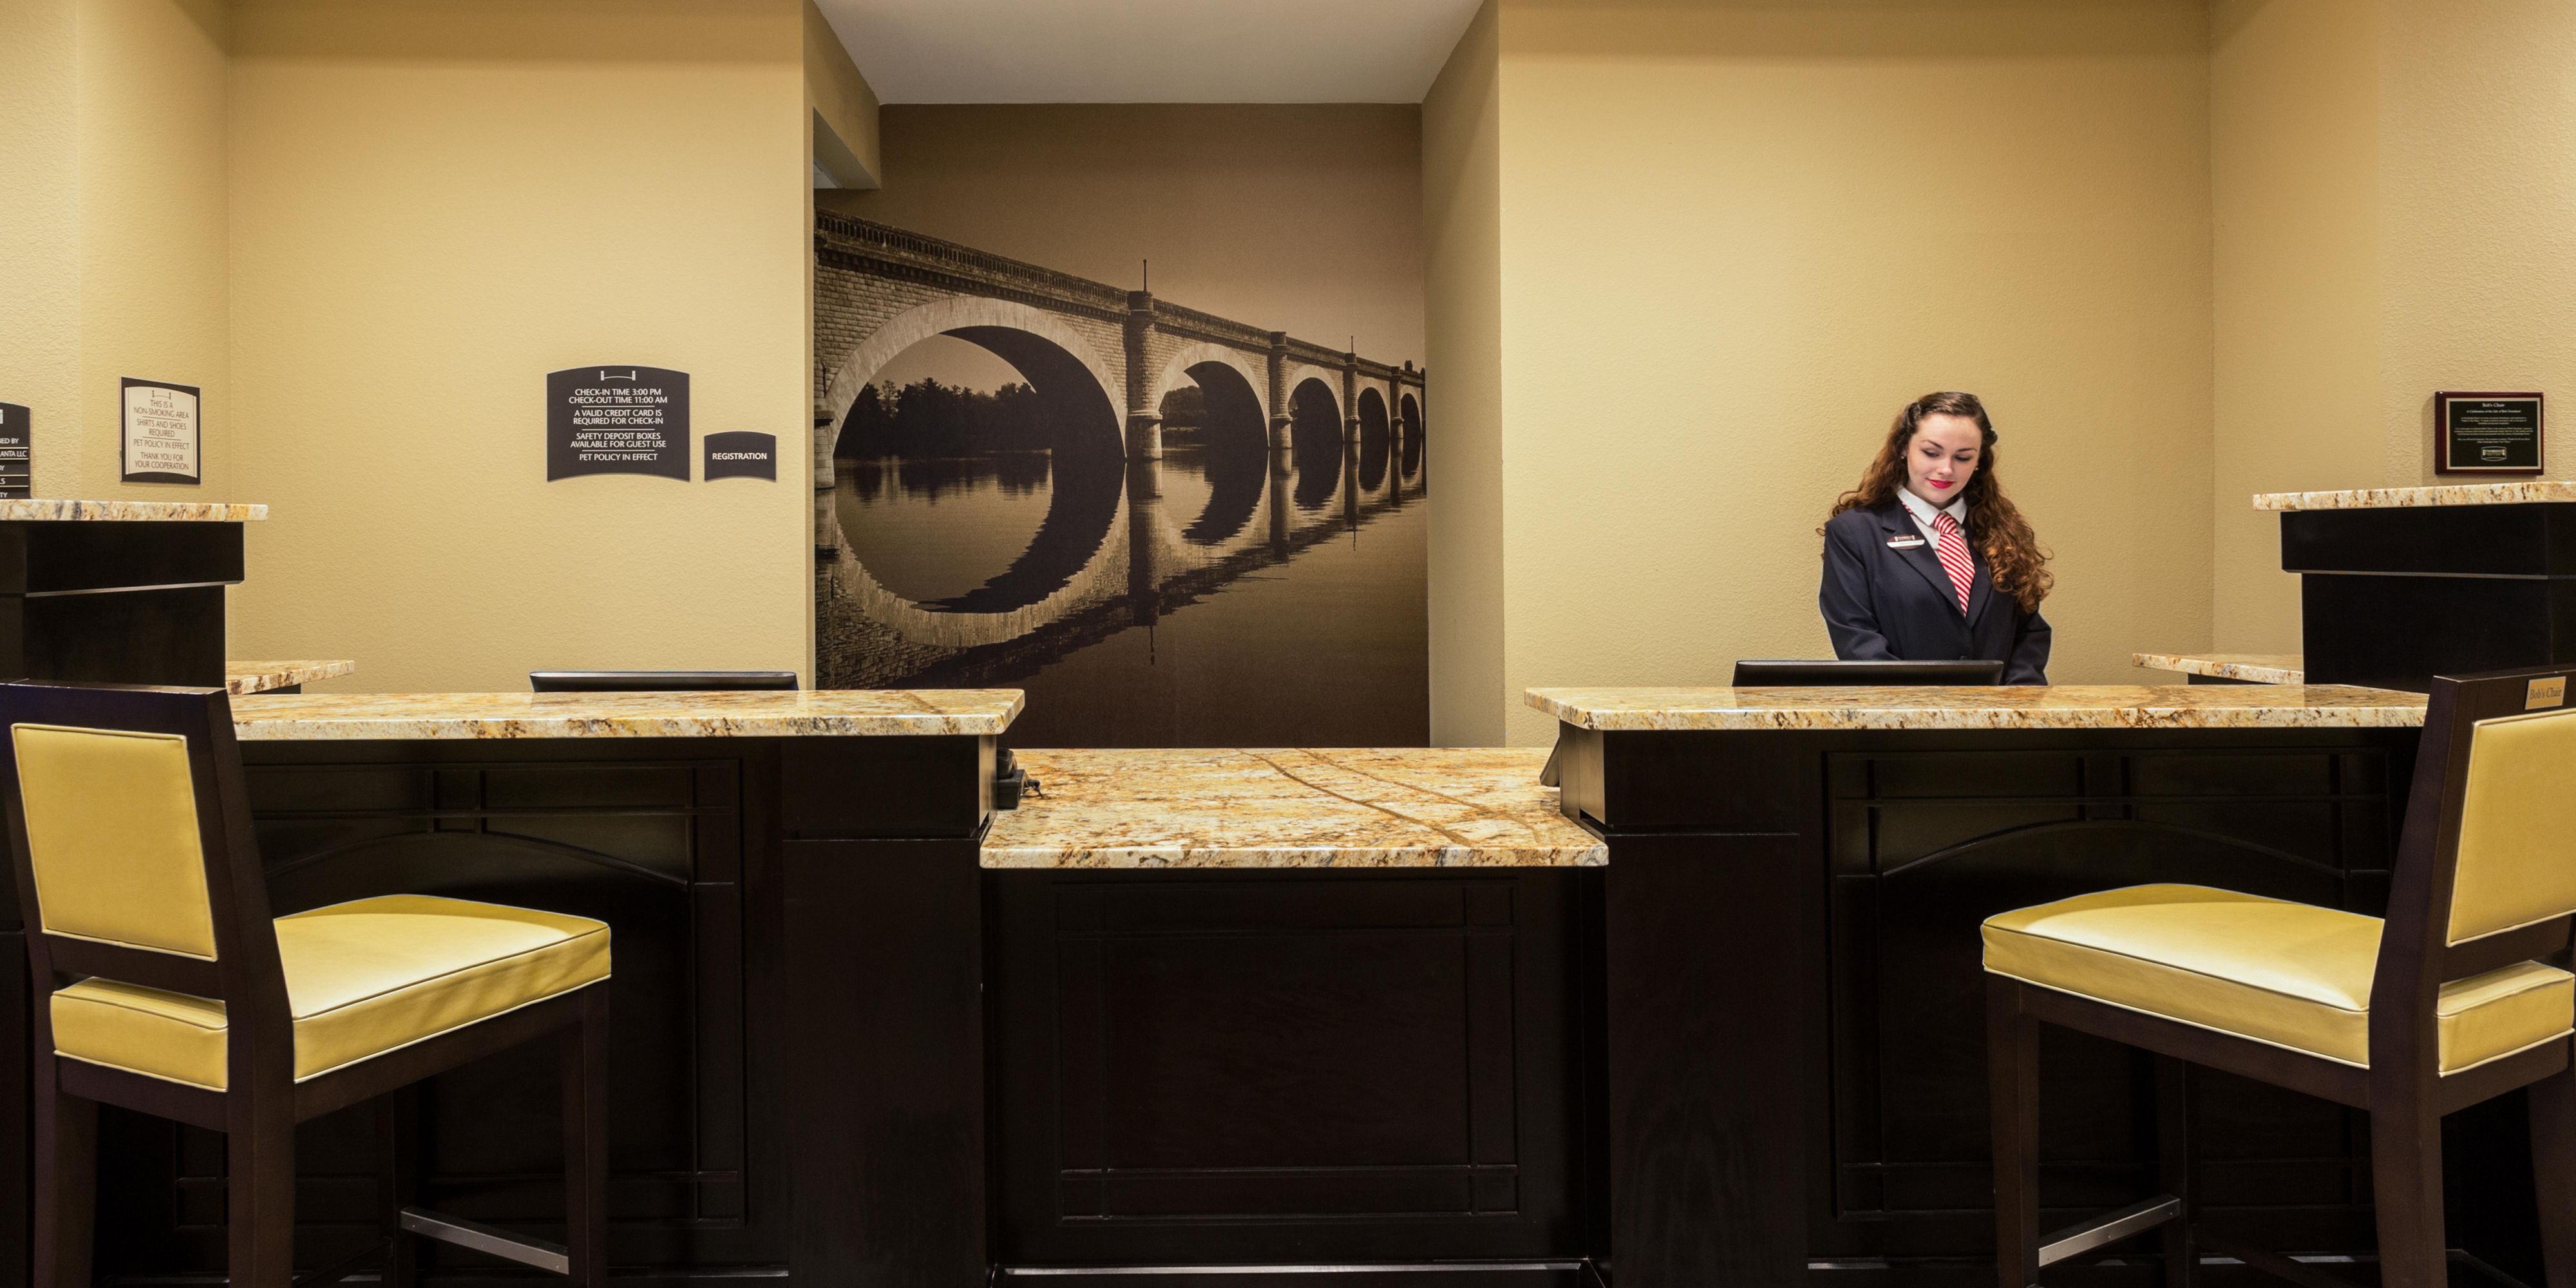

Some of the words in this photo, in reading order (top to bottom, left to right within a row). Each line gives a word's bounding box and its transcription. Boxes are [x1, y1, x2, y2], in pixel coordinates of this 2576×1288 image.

[134, 407, 175, 417] NON-SMOKING
[137, 418, 154, 427] SHIRTS
[149, 428, 175, 437] REQUIRED
[151, 461, 189, 470] COOPERATION
[2530, 688, 2545, 699] Bob's
[2546, 687, 2561, 698] Chair
